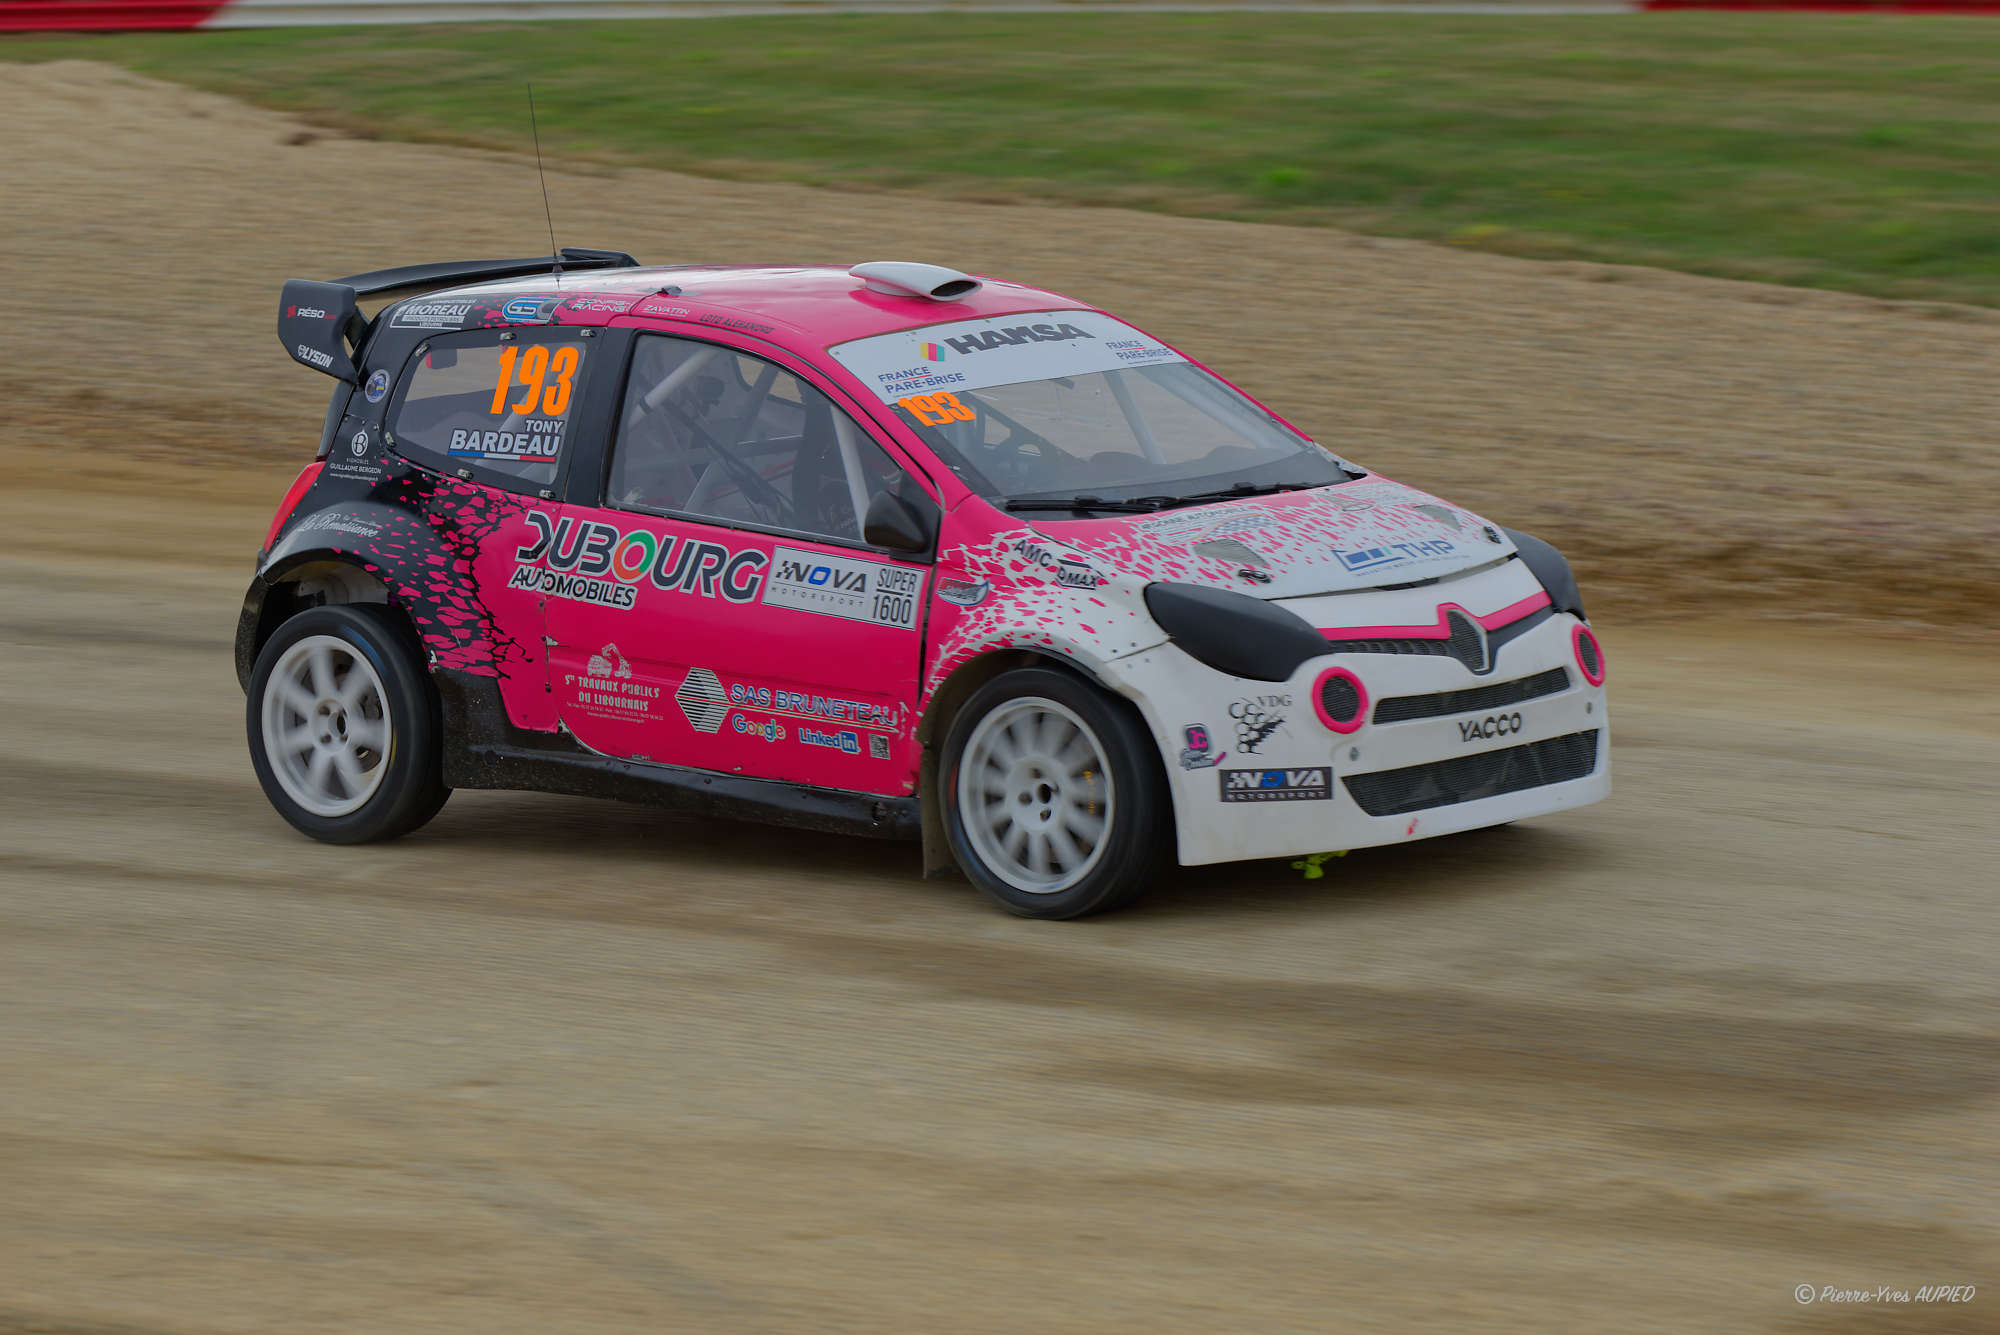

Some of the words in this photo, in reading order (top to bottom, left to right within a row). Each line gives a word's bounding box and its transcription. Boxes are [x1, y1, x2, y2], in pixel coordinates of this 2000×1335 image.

[405, 304, 471, 316] MOREAU
[571, 304, 625, 313] RACING
[943, 323, 1097, 355] HAMSA
[1105, 340, 1144, 350] FRANCE
[1115, 348, 1174, 360] PARE-BRISE
[490, 346, 579, 416] 193
[878, 366, 931, 382] FRANCE
[884, 373, 966, 393] PARE-BRISE
[897, 392, 976, 427] 193
[525, 420, 563, 433] TONY
[449, 429, 561, 456] BARDEAU
[514, 509, 770, 604] DUBOURG
[1013, 540, 1052, 567] AMC
[1391, 540, 1456, 557] THP
[777, 560, 868, 593] NOVA
[877, 568, 918, 593] SUPER
[872, 595, 913, 625] 1600
[578, 676, 618, 693] TRAVAUX
[621, 682, 660, 699] PUBLICS
[578, 690, 592, 704] DU
[594, 693, 649, 712] LIBOURNAIS
[730, 683, 771, 706] SAS
[775, 689, 898, 726] BRUNETEAU
[1256, 694, 1293, 707] VDG
[732, 713, 786, 742] Google
[1458, 711, 1522, 743] YACCO
[1226, 769, 1326, 788] NOVA
[1226, 791, 1326, 801] MOTORSPORT
